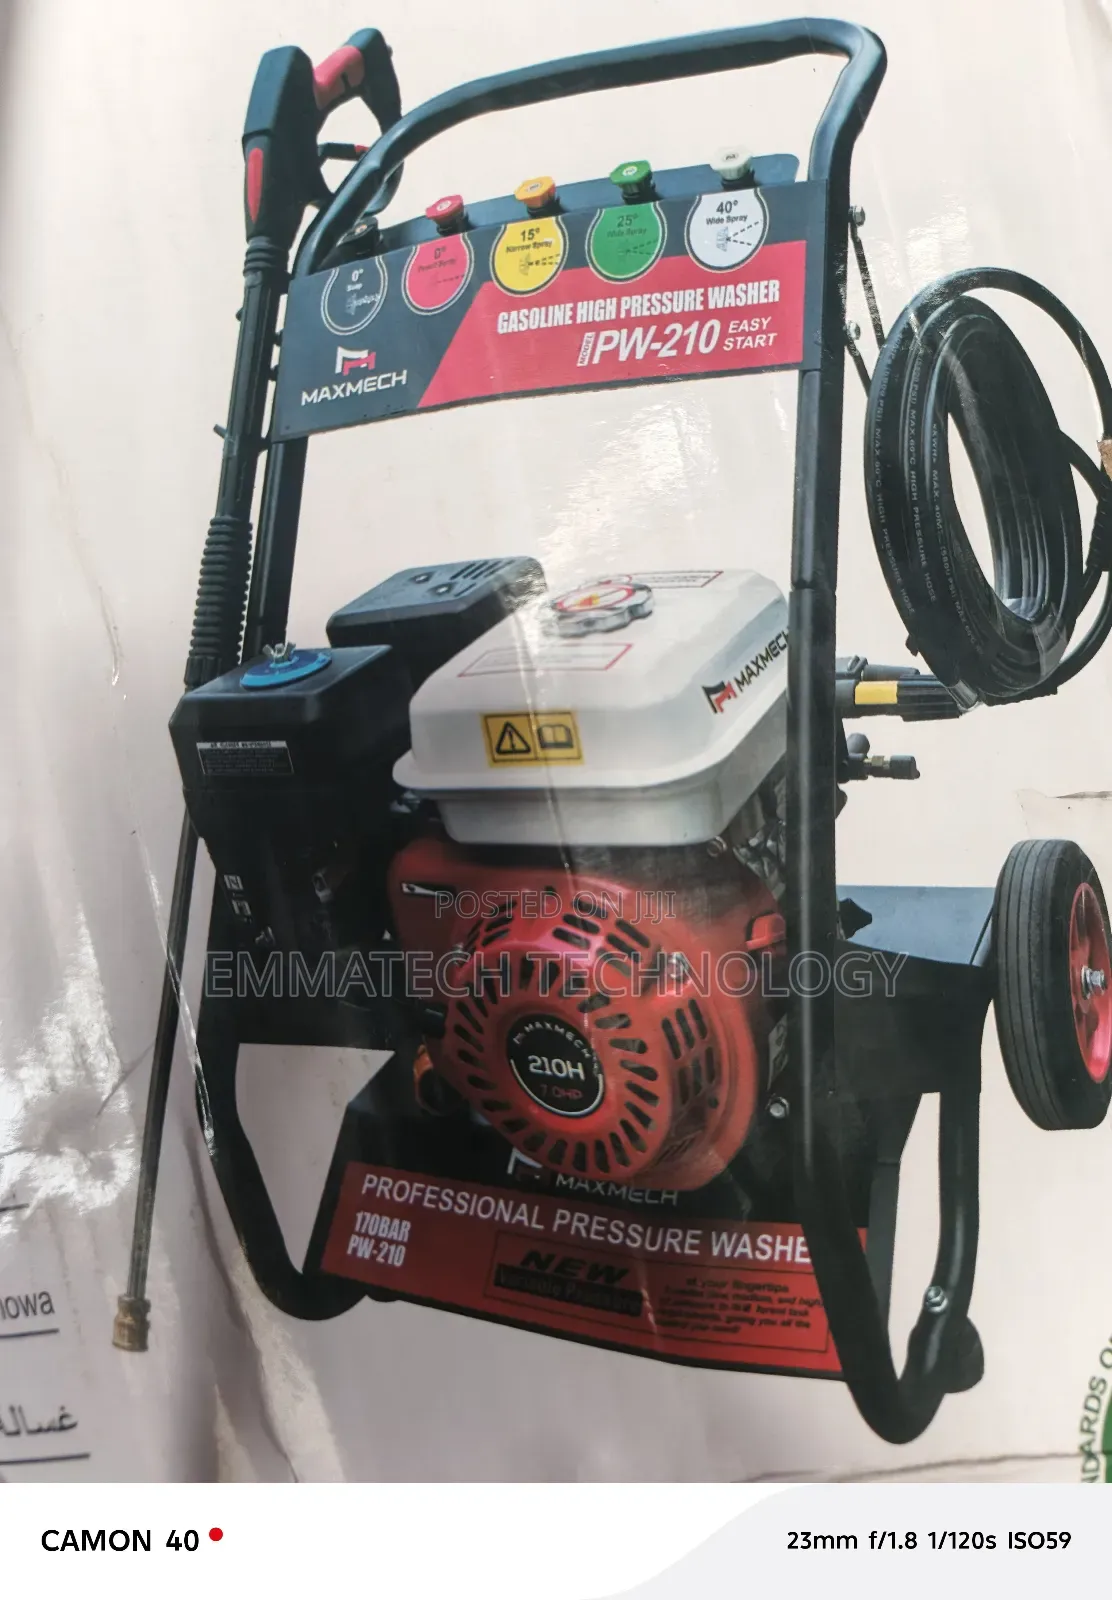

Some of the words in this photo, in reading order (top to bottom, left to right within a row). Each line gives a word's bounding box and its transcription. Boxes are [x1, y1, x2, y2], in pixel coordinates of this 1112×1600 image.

[617, 213, 638, 228] 25°
[706, 216, 724, 226] Wide
[726, 214, 748, 224] Spray
[716, 199, 738, 214] 40°
[520, 227, 540, 242] 15°
[497, 303, 573, 334] GASOLINE
[576, 297, 617, 325] HIGH
[620, 289, 704, 319] PRESSURE
[708, 280, 780, 310] WASHER
[723, 332, 778, 351] START
[728, 316, 772, 334] EASY
[578, 333, 594, 366] MODEL
[592, 318, 721, 365] PW-210
[301, 369, 408, 406] MAXMECH
[910, 470, 918, 500] HIGH
[876, 492, 886, 523] HIGH
[882, 527, 903, 585] PRESSURE
[899, 588, 916, 614] HOSE
[912, 506, 928, 569] PRESSURE
[924, 571, 937, 604] HOSE
[524, 1020, 592, 1059] MAXMECH
[527, 1054, 586, 1082] 210H
[556, 1173, 678, 1206] MAXMECH
[354, 1211, 412, 1243] 170BAR
[361, 1173, 544, 1230] PROFESSIONAL
[552, 1208, 703, 1256] PRESSURE
[711, 1230, 811, 1264] WASHE
[346, 1234, 406, 1267] PW-210
[520, 1250, 629, 1284] NEW
